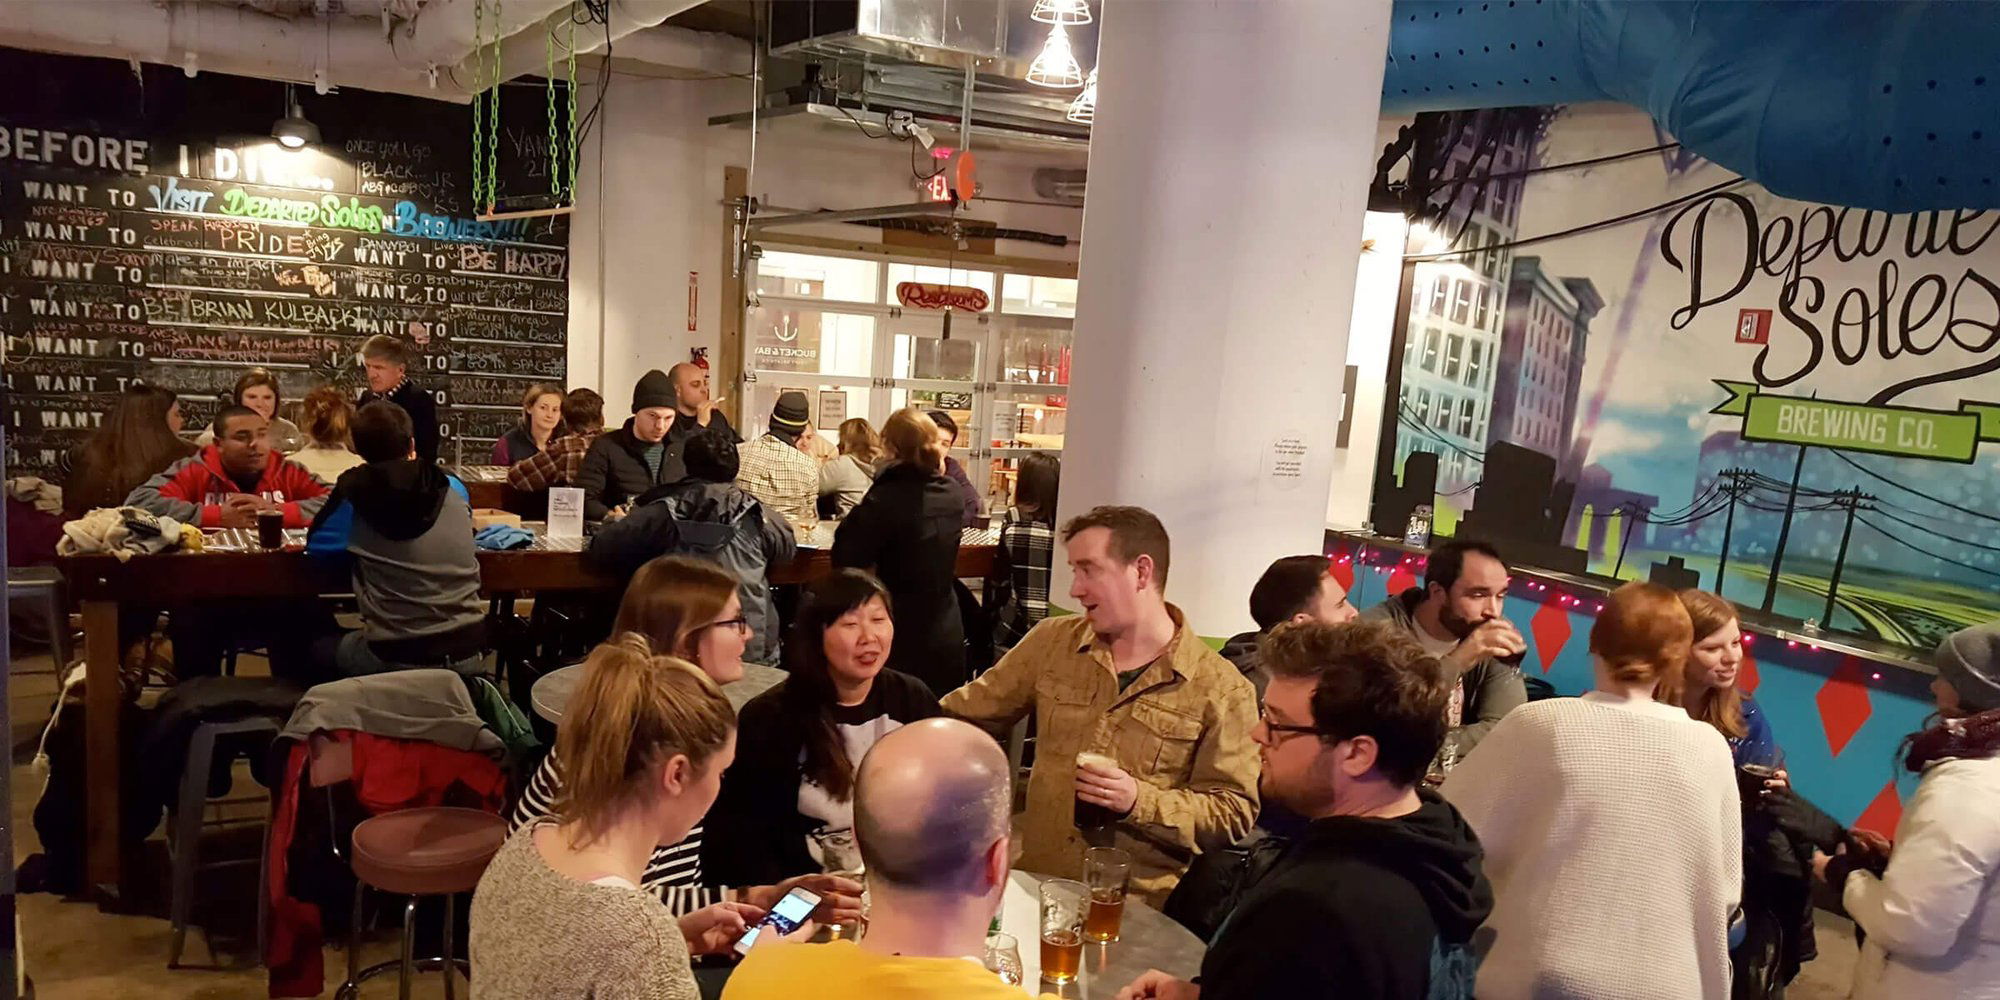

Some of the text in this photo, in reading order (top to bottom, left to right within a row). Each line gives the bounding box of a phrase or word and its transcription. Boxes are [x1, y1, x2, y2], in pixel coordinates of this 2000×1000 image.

[22, 180, 137, 208] WANT TO
[24, 220, 137, 246] WANT TO
[220, 227, 305, 255] PRIDE
[354, 247, 407, 267] WANT
[422, 252, 447, 271] TO
[505, 247, 567, 280] HAPPY
[30, 258, 97, 281] WANT
[113, 264, 143, 284] TO
[355, 282, 408, 300] WANT
[424, 286, 448, 302] TO
[30, 298, 94, 319] WANT
[112, 303, 142, 321] TO
[142, 297, 180, 316] BE
[190, 298, 254, 320] BRIAN
[355, 318, 408, 337] WANT
[424, 321, 447, 338] TO
[35, 336, 100, 357] WANT
[117, 340, 146, 358] TO
[423, 355, 448, 371] TO
[34, 374, 98, 392] WANT
[13, 410, 104, 429] I WANT
[1777, 404, 1938, 450] BREWING CO.
